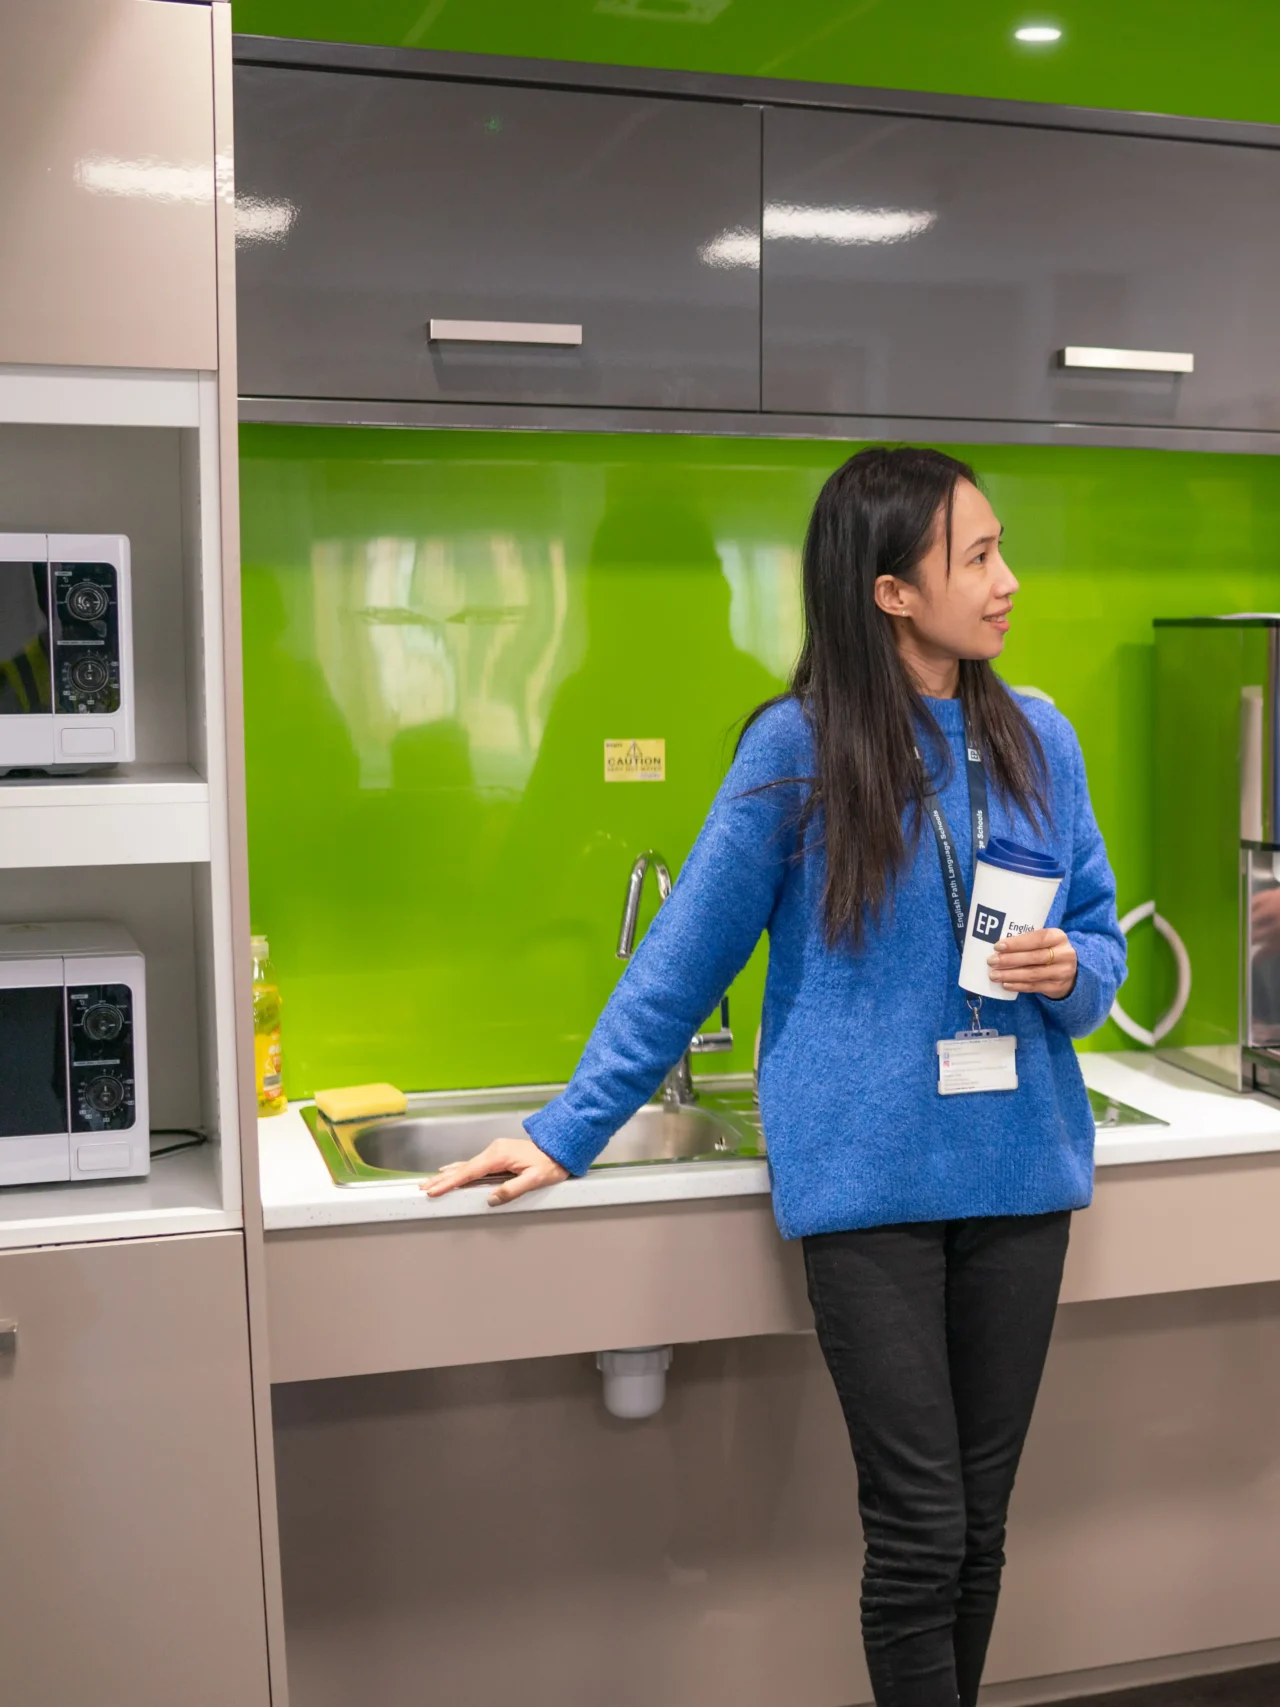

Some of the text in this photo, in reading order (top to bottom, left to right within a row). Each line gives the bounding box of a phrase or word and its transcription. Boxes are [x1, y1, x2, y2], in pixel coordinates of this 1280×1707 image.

[608, 757, 661, 765] CAUTION
[933, 810, 965, 928] English Path Language Schools
[976, 911, 1000, 936] EP
